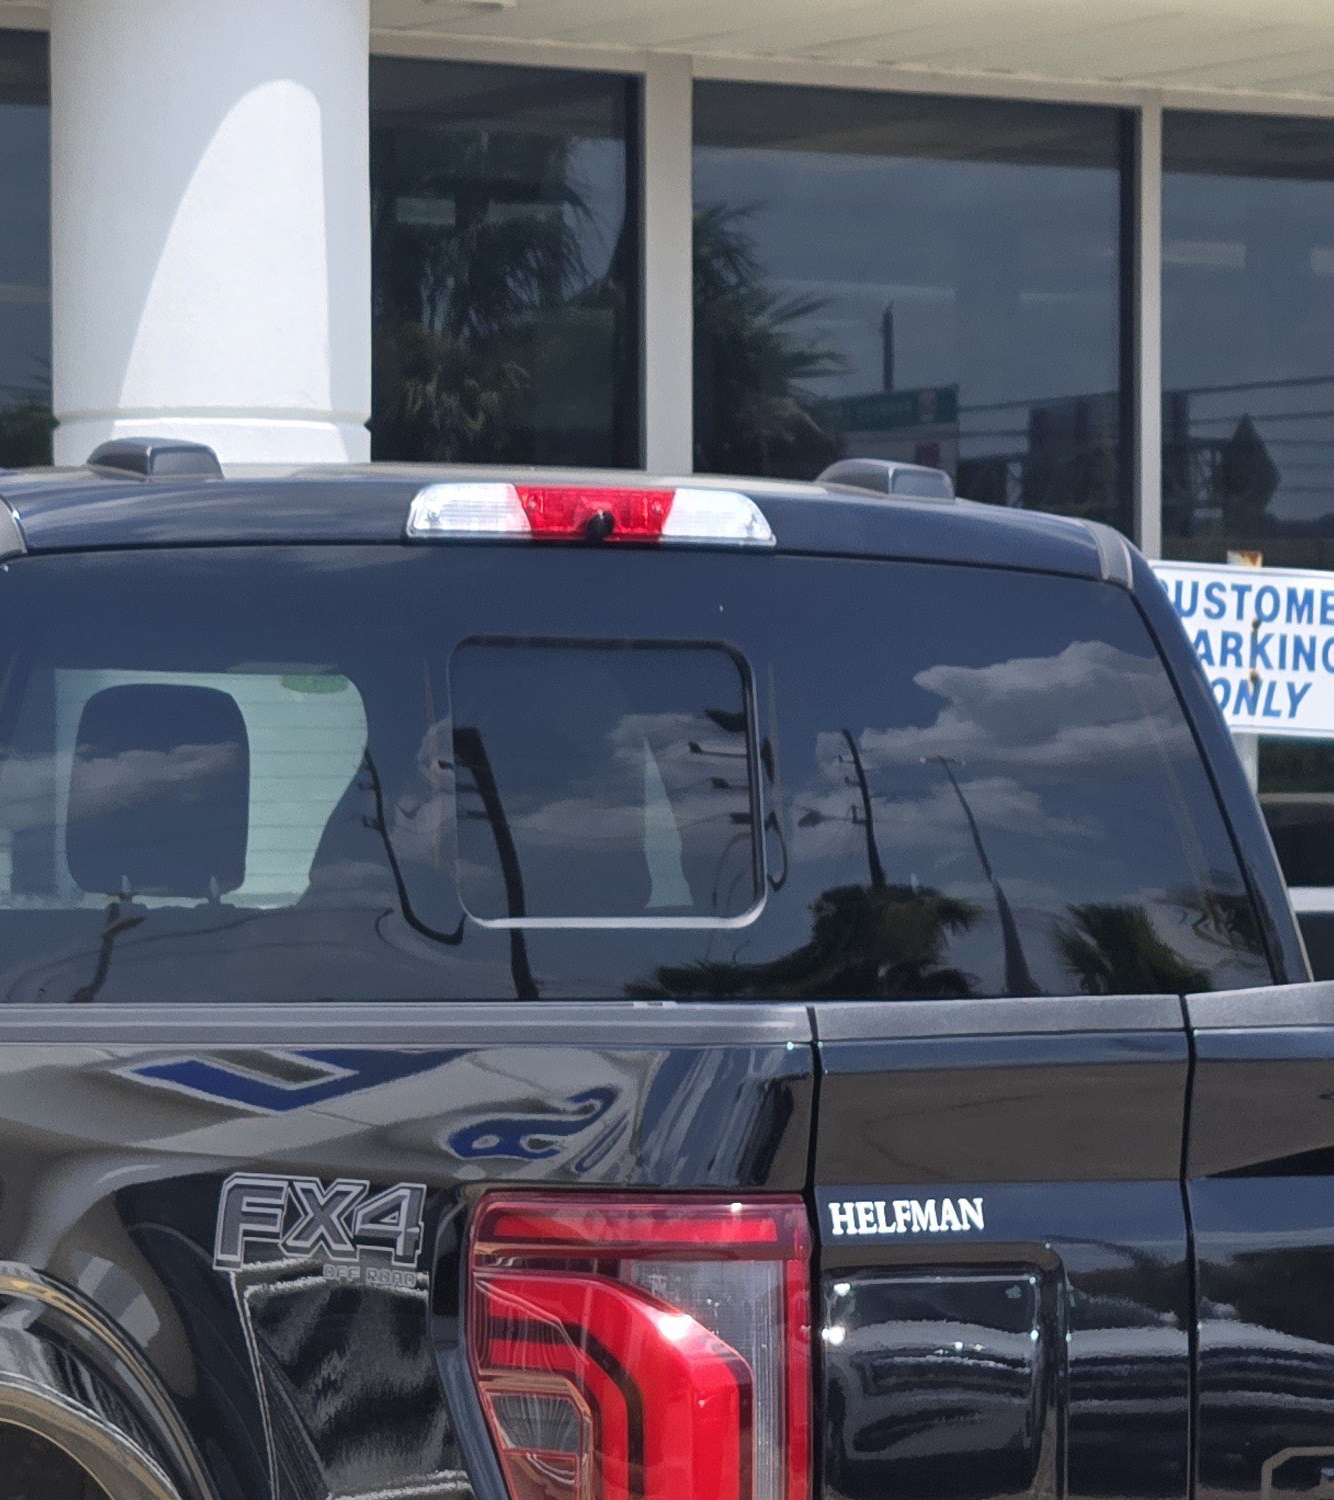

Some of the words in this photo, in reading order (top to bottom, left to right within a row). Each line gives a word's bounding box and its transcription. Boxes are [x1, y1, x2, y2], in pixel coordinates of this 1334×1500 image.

[1210, 677, 1313, 719] ONLY
[212, 1172, 427, 1271] FX4
[828, 1198, 985, 1235] HELFMAN
[323, 1264, 361, 1281] OFF
[366, 1267, 417, 1288] ROAD
